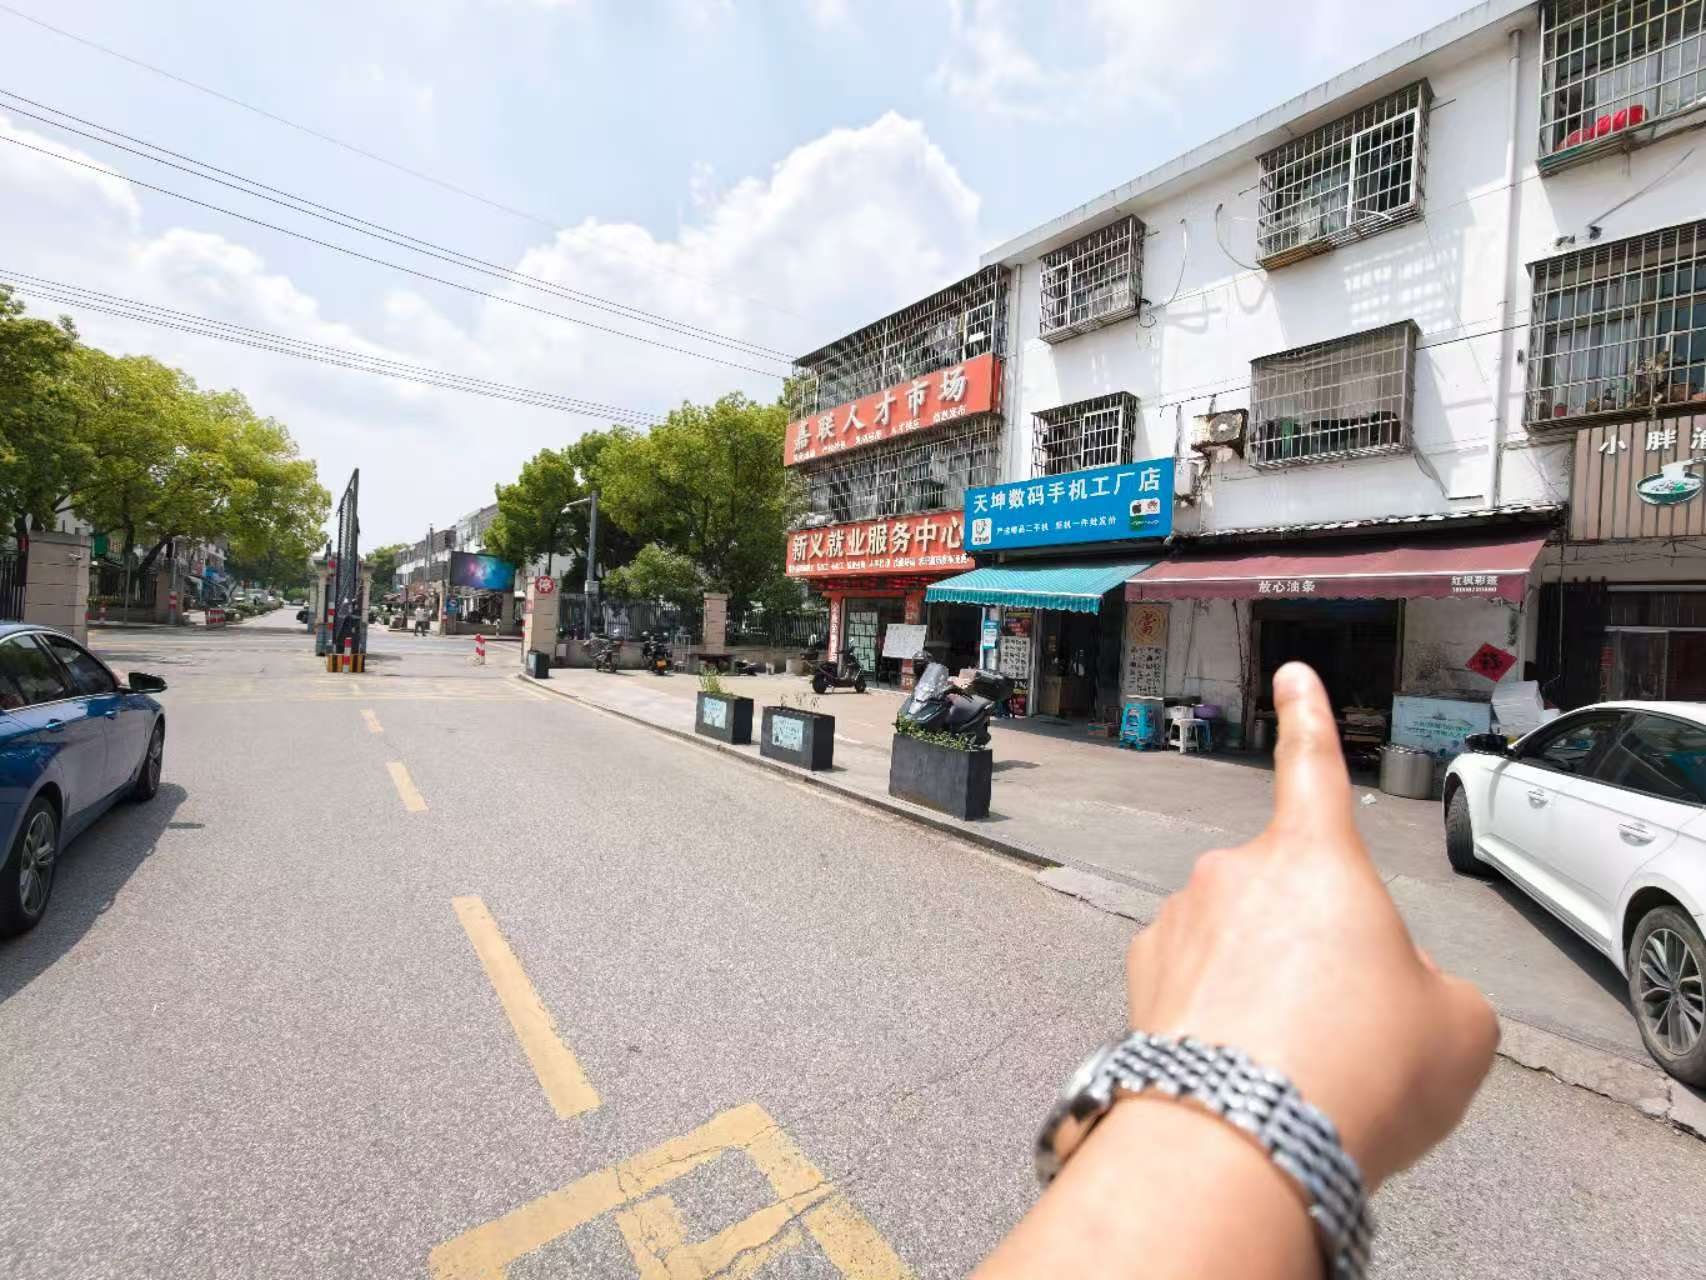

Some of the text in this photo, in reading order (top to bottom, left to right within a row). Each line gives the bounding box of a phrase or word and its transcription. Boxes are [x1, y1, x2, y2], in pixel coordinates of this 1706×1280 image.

[973, 467, 1161, 514] 天坤数码手机工厂店
[792, 518, 963, 561] 新义就业服务中心
[1258, 579, 1316, 593] 放心油条
